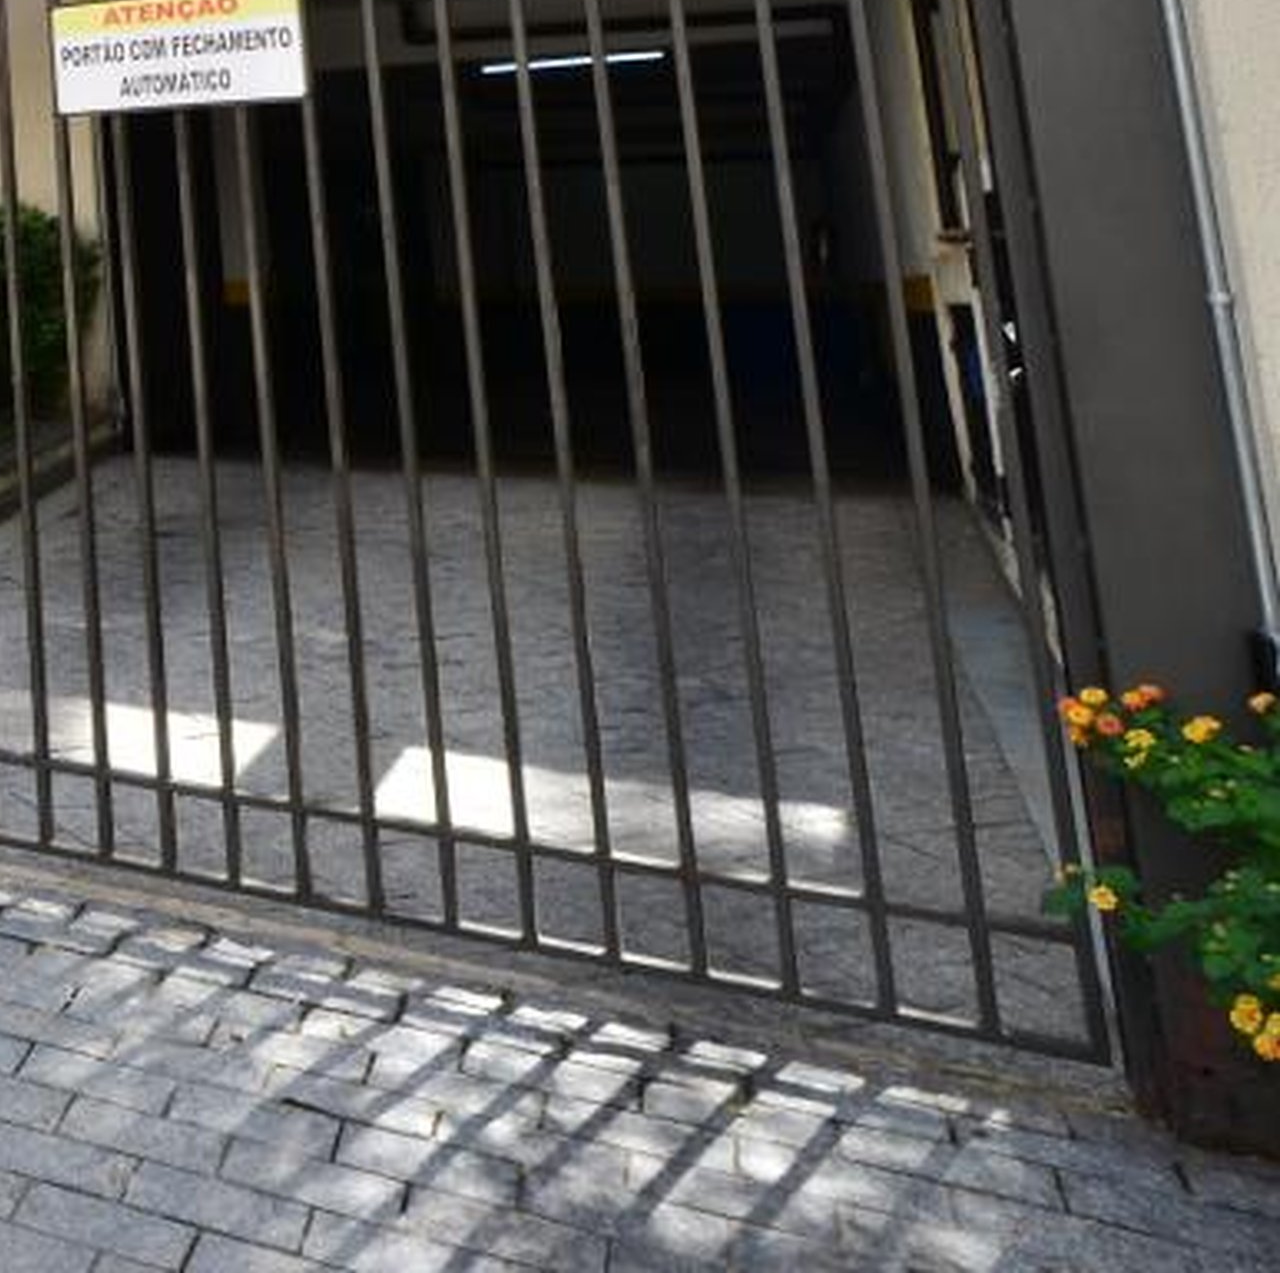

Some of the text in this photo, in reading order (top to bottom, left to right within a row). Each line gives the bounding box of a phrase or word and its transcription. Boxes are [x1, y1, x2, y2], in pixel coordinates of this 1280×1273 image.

[60, 26, 292, 69] PORTÃO COM FECHAMENTO
[119, 67, 232, 99] AUTOMÁTICO
